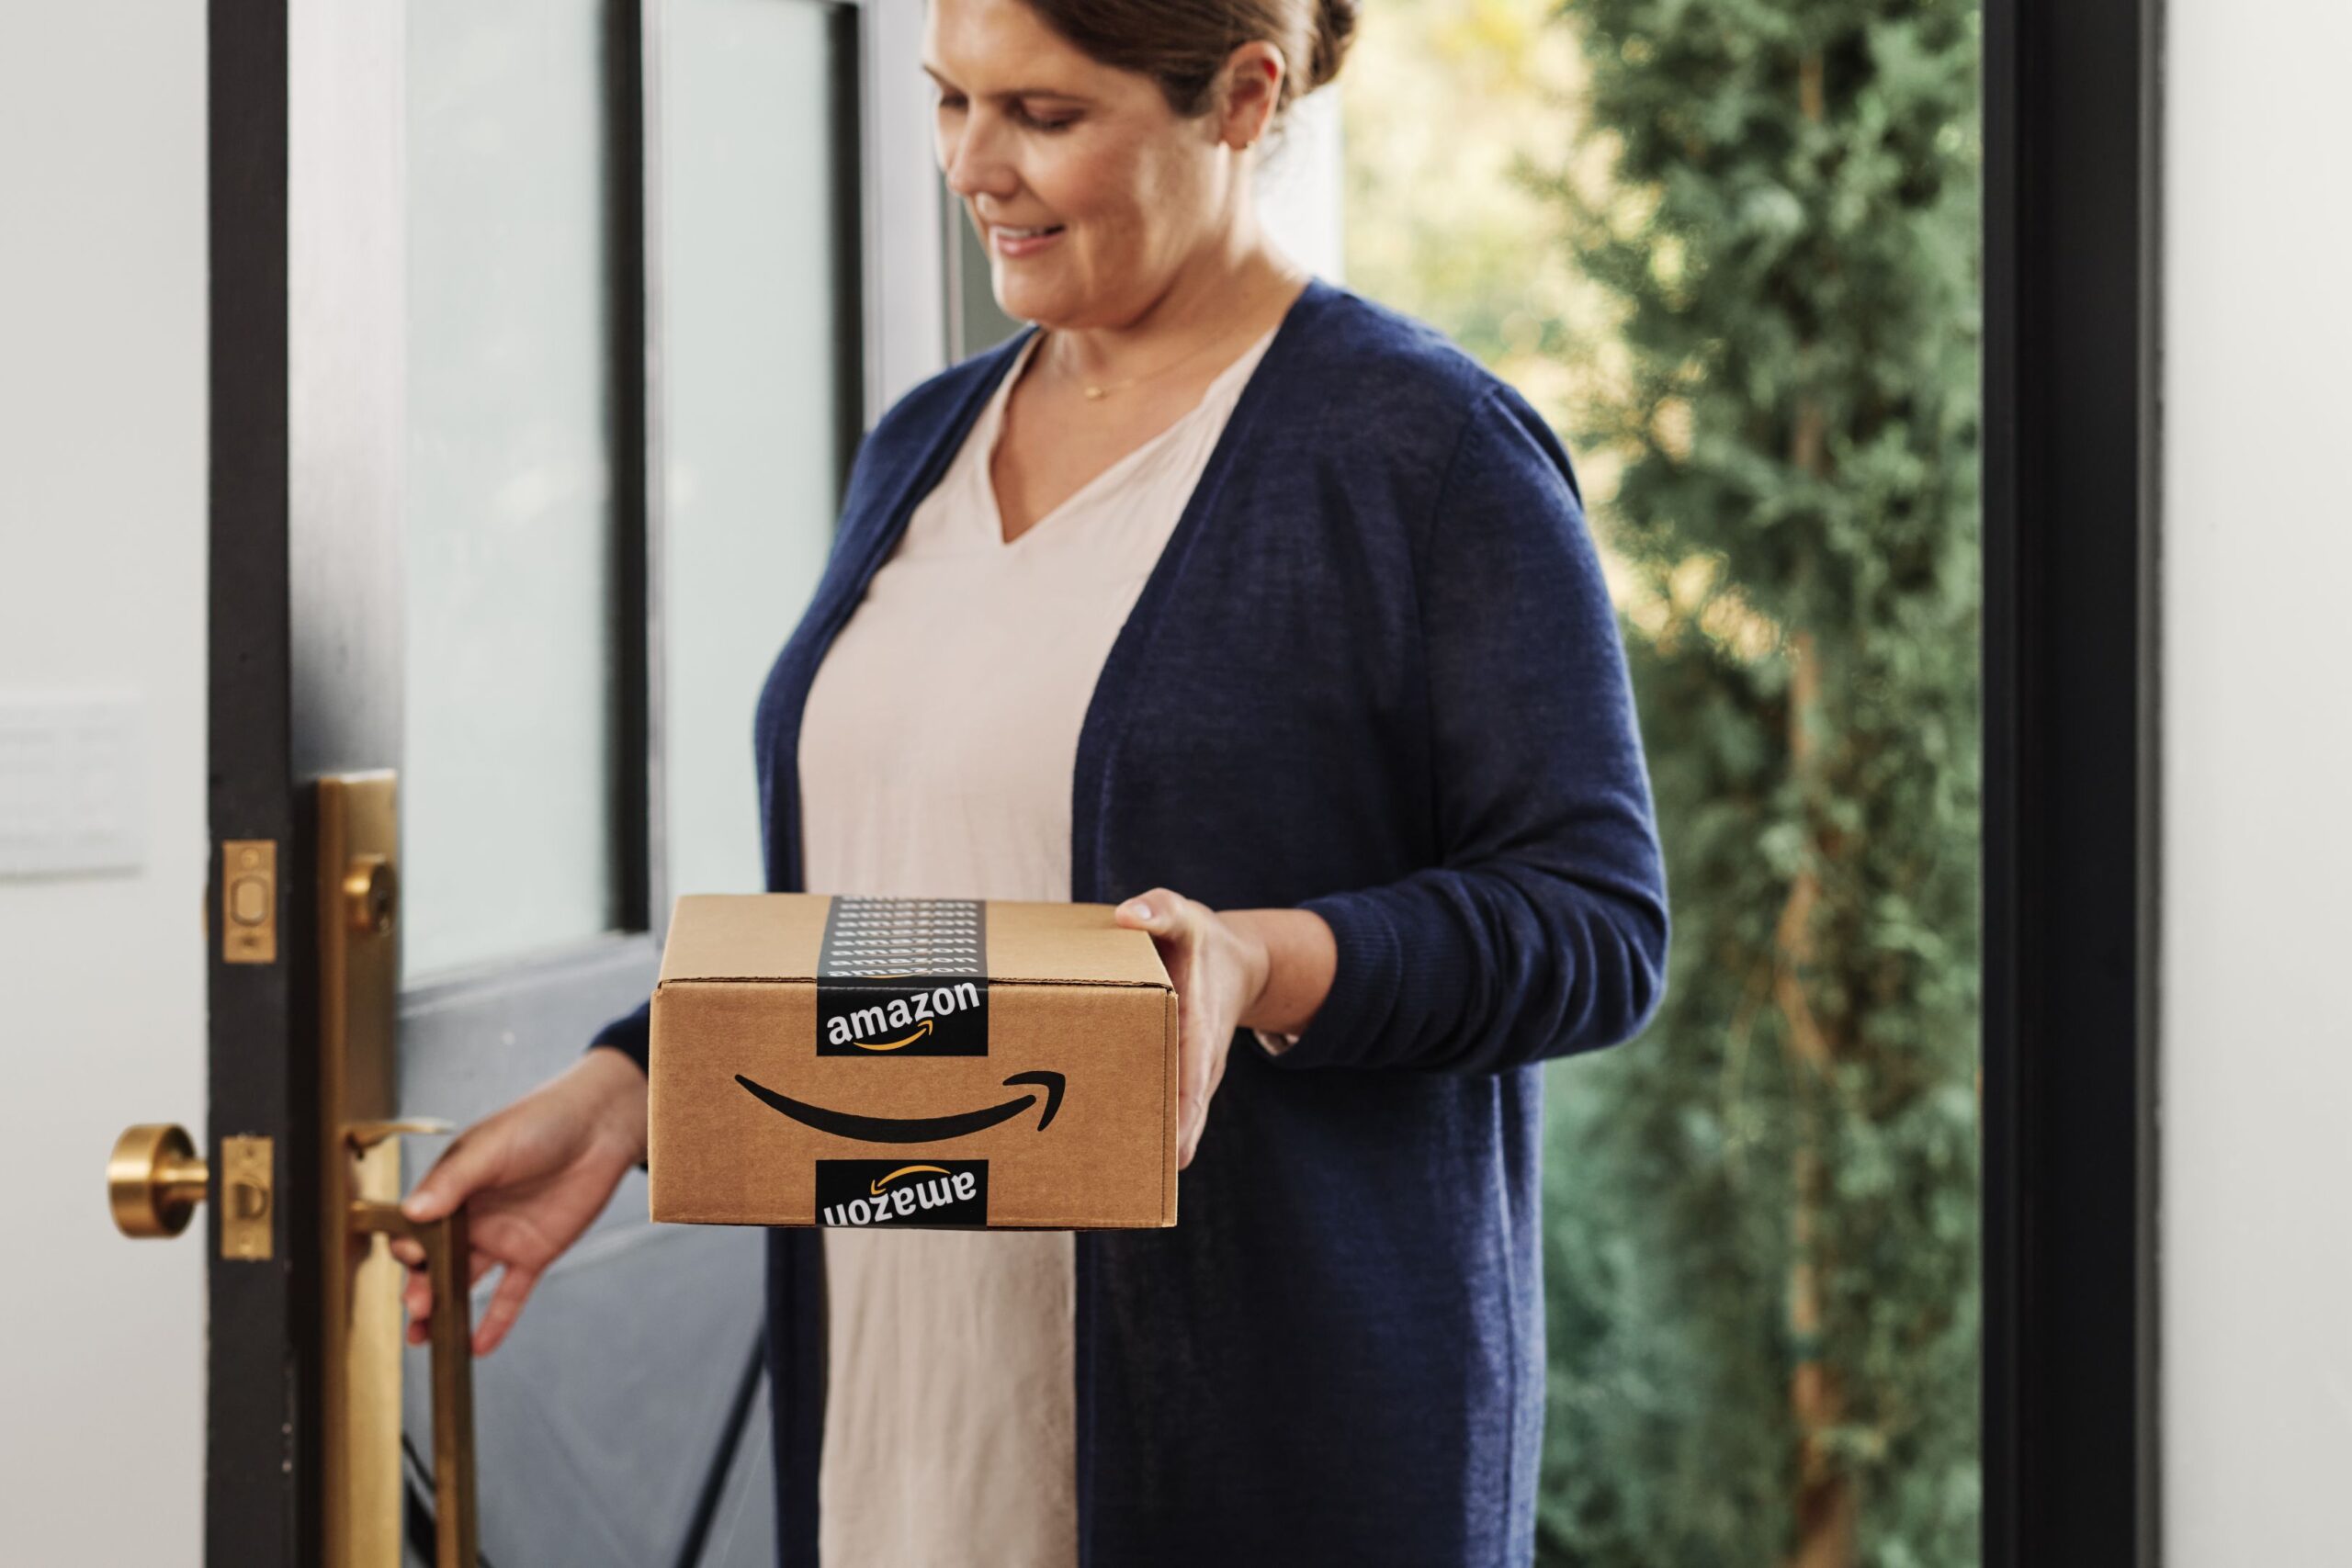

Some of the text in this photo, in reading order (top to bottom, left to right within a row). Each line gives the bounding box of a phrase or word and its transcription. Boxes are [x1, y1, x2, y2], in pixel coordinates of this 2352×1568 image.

[831, 947, 978, 956] amazon
[829, 957, 978, 966] amazon
[828, 967, 978, 976] amazon
[827, 982, 980, 1045] amazon
[823, 1171, 977, 1227] amazon
